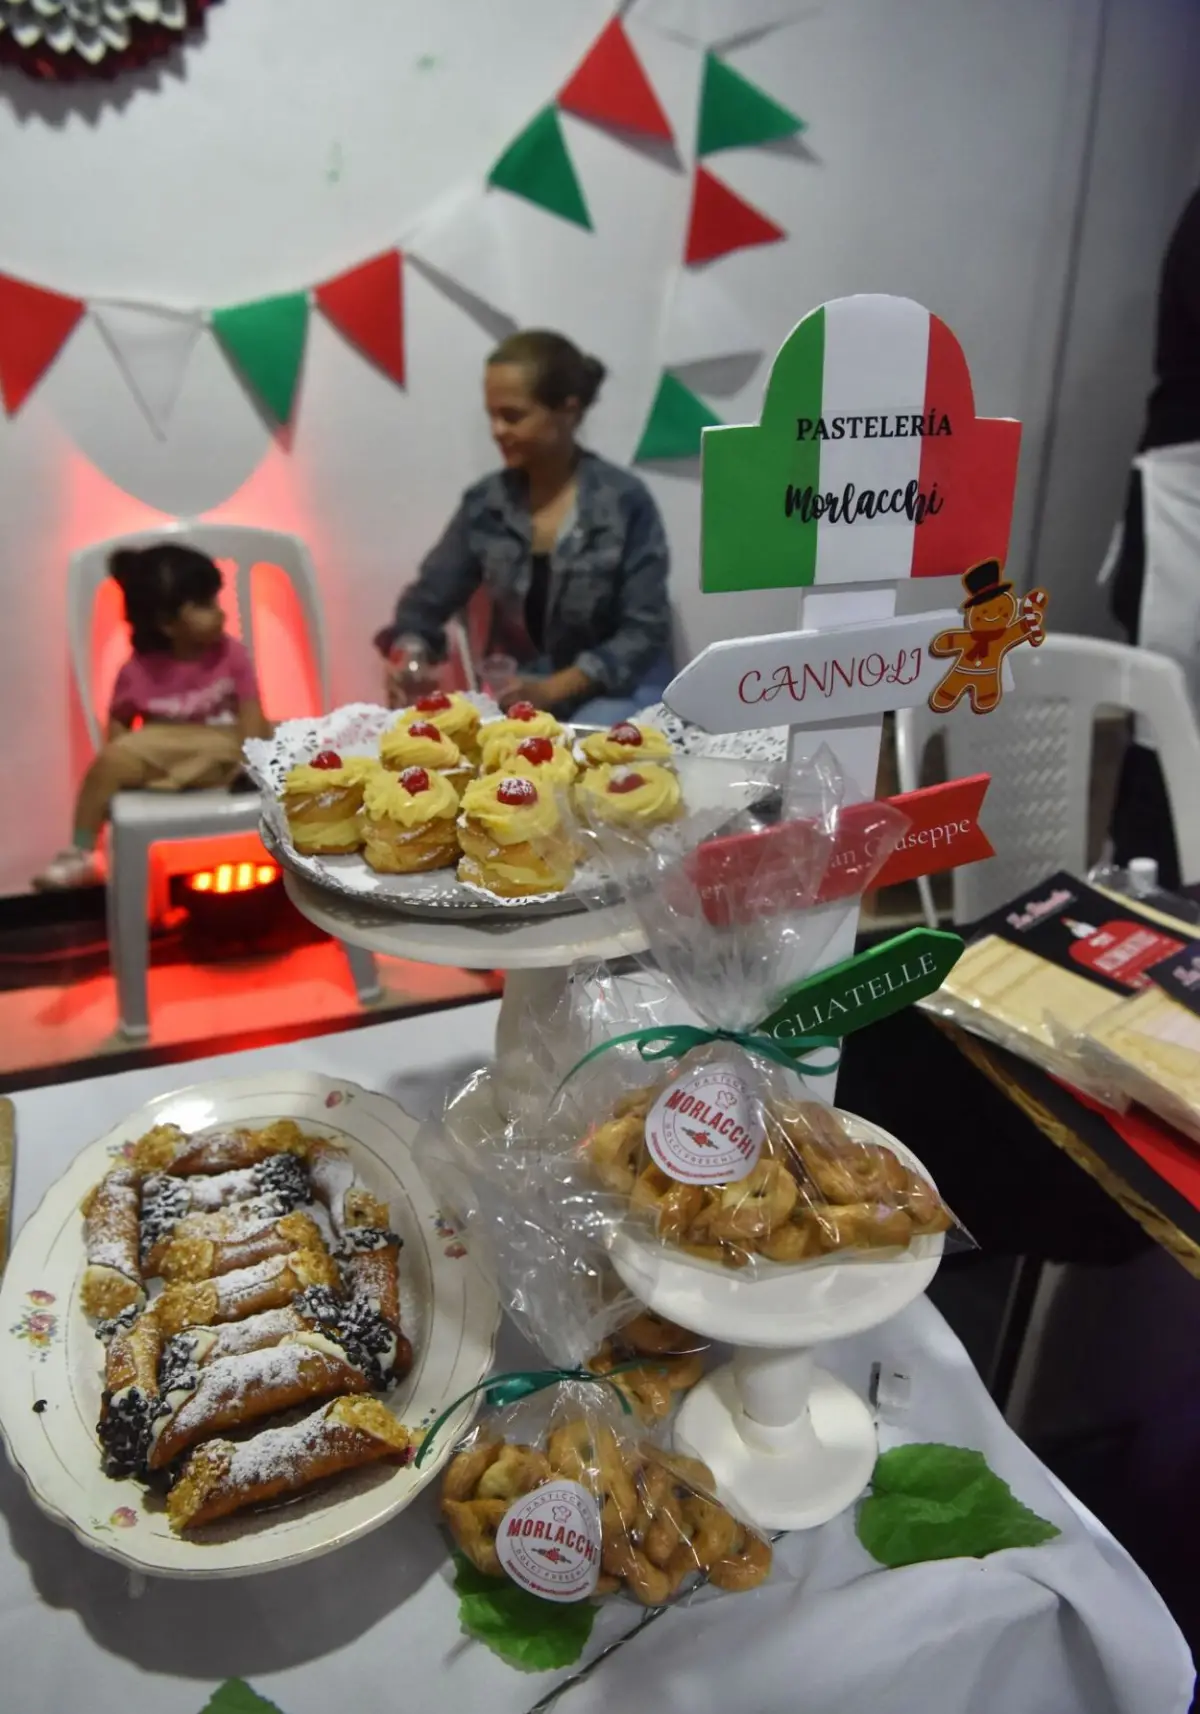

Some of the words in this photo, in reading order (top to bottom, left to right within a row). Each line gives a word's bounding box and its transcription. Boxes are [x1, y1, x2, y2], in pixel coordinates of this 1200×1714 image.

[796, 408, 953, 441] PASTELERÍA
[785, 479, 944, 525] Morlacchi
[738, 647, 922, 704] CANNOLI
[664, 1089, 756, 1160] MORLACCHI
[506, 1518, 598, 1565] MORLACCHI
